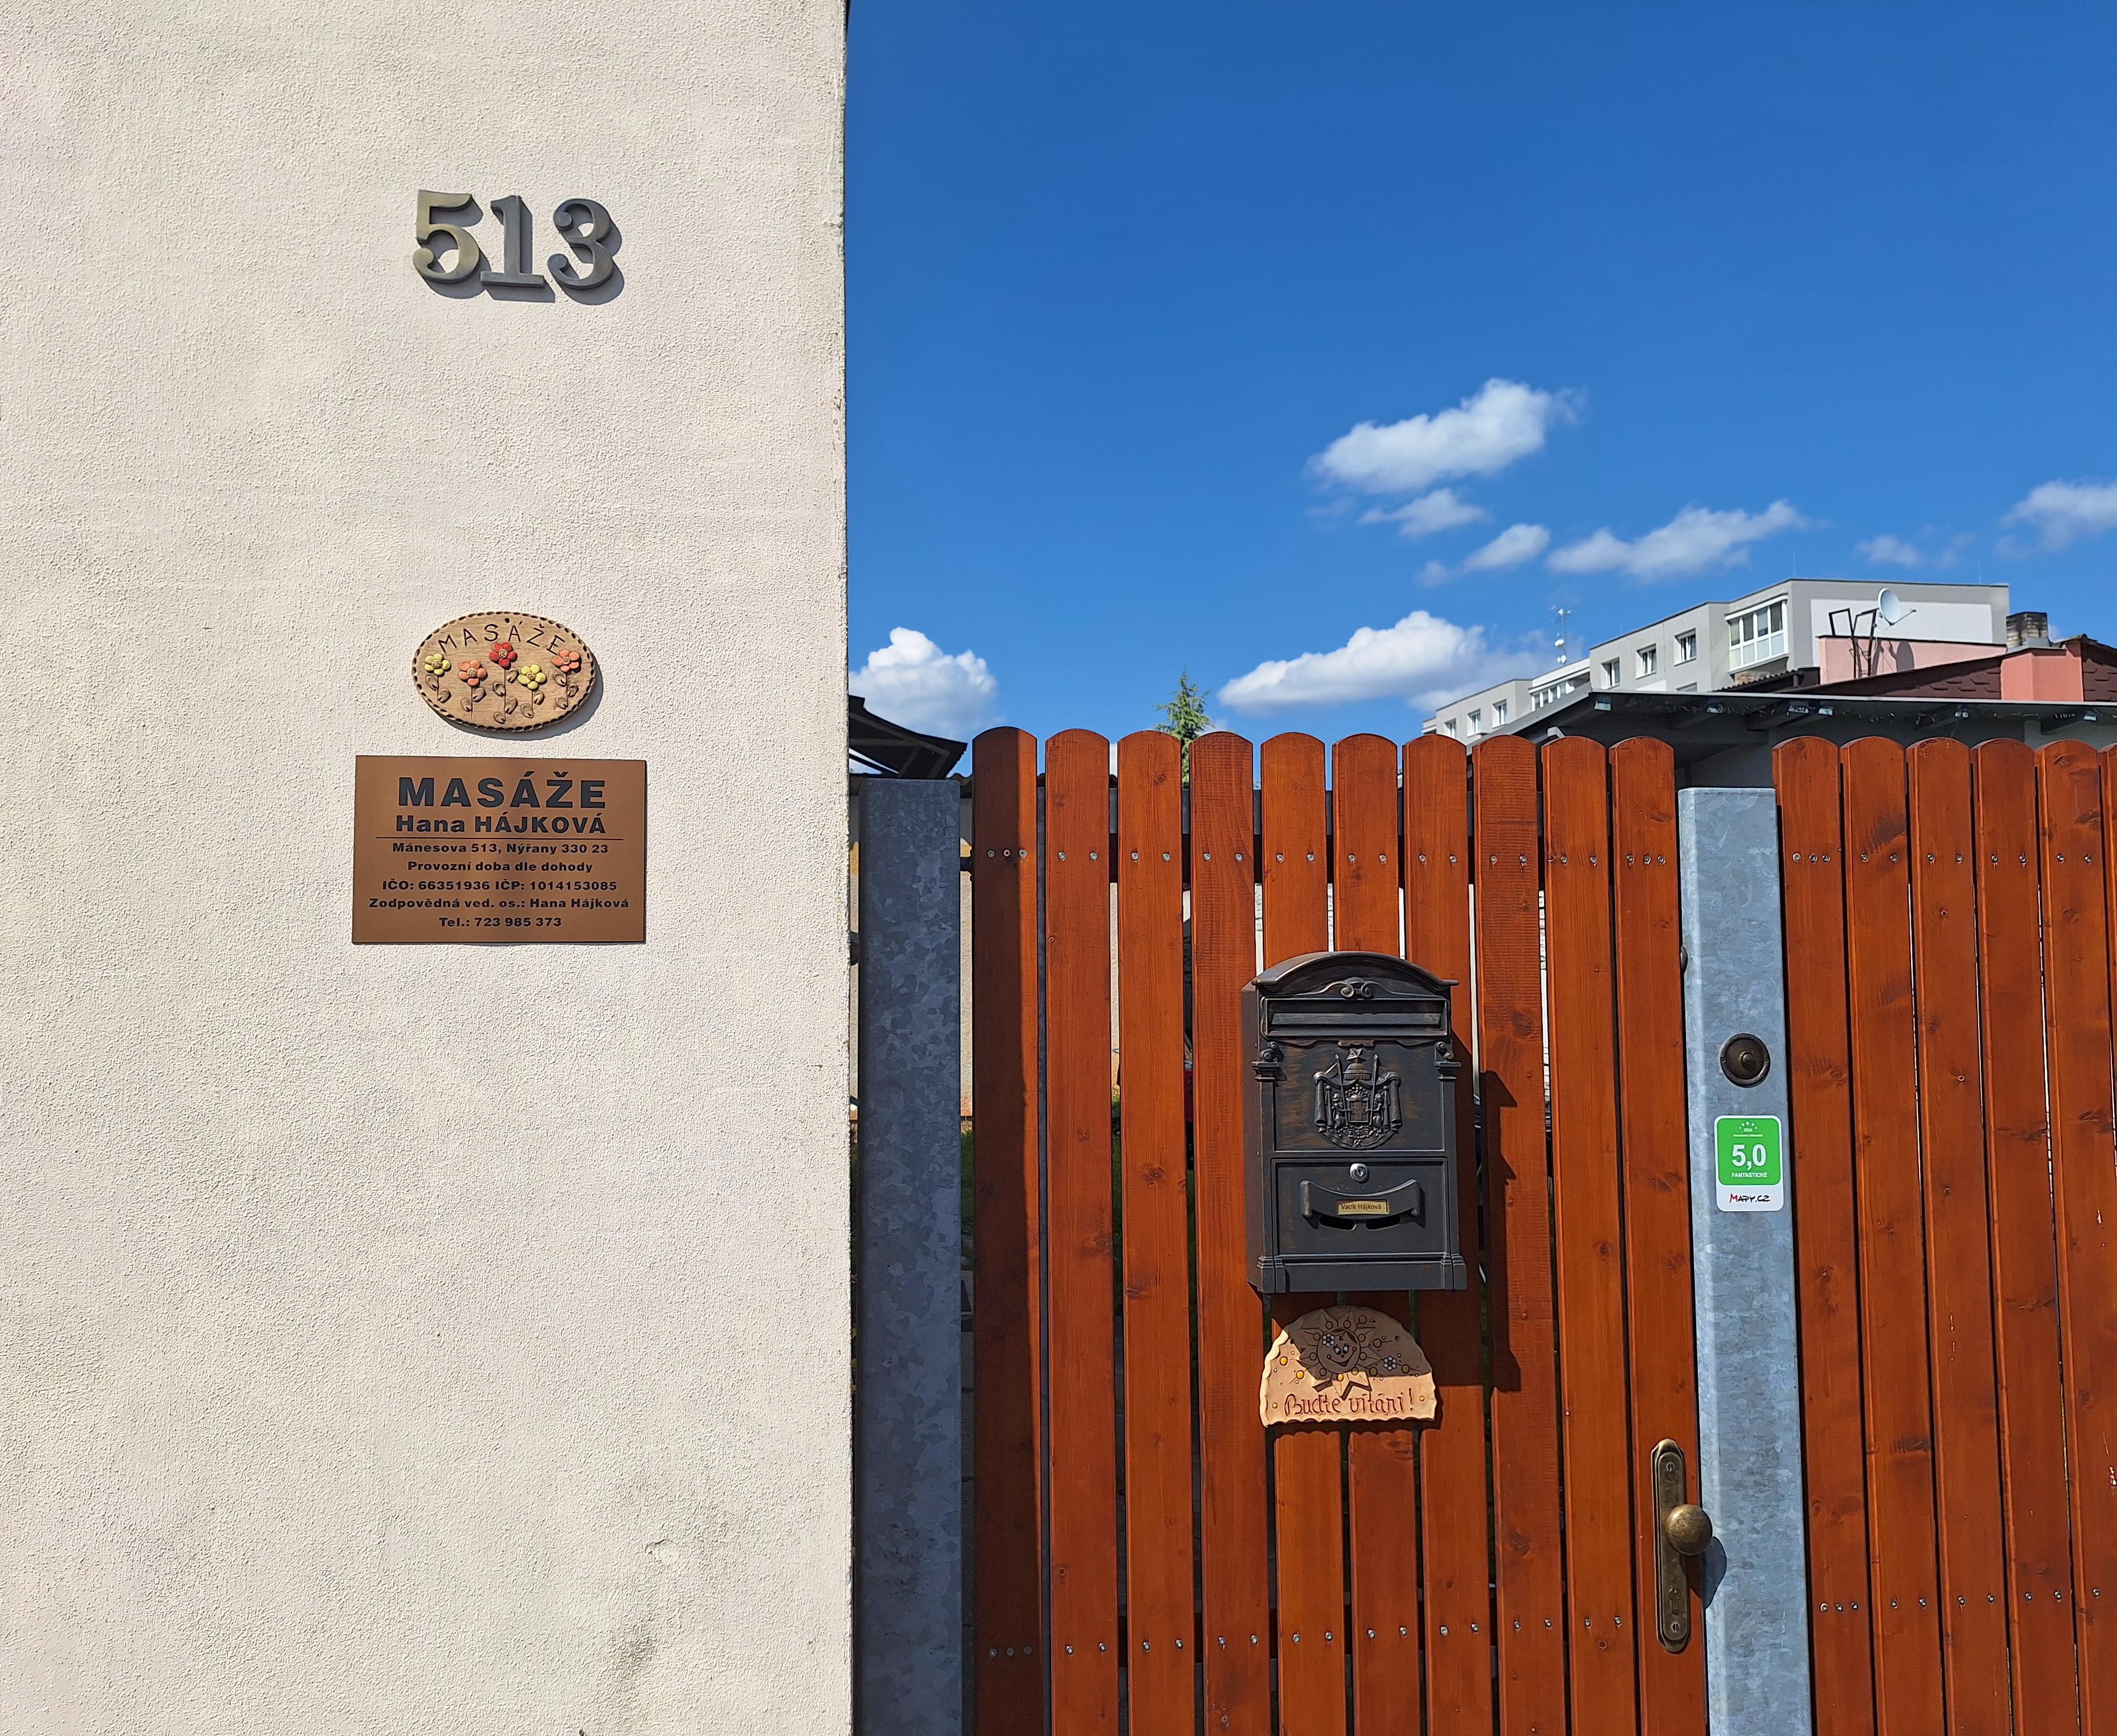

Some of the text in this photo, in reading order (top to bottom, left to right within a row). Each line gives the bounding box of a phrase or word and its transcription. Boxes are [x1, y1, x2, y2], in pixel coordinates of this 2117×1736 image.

[412, 189, 613, 290] 513
[438, 620, 565, 656] MASÁŽE
[398, 771, 606, 809] MASÁŽE
[396, 811, 606, 834] Hana HÁJKOVÁ
[392, 843, 608, 855] Mánesova 513, Nýřany 330 23
[408, 861, 593, 873] Provozní doba dle dohody
[383, 878, 617, 891] IČO: 66351936 IČP: 1014153085
[369, 898, 460, 910] Zodpovědná
[464, 898, 494, 908] ved.
[530, 898, 566, 908] Hana
[571, 898, 629, 910] Hájková
[439, 917, 561, 927] Tel.: 723 985 373
[1731, 1143, 1766, 1171] 5,0
[1358, 1203, 1381, 1211] Hájková
